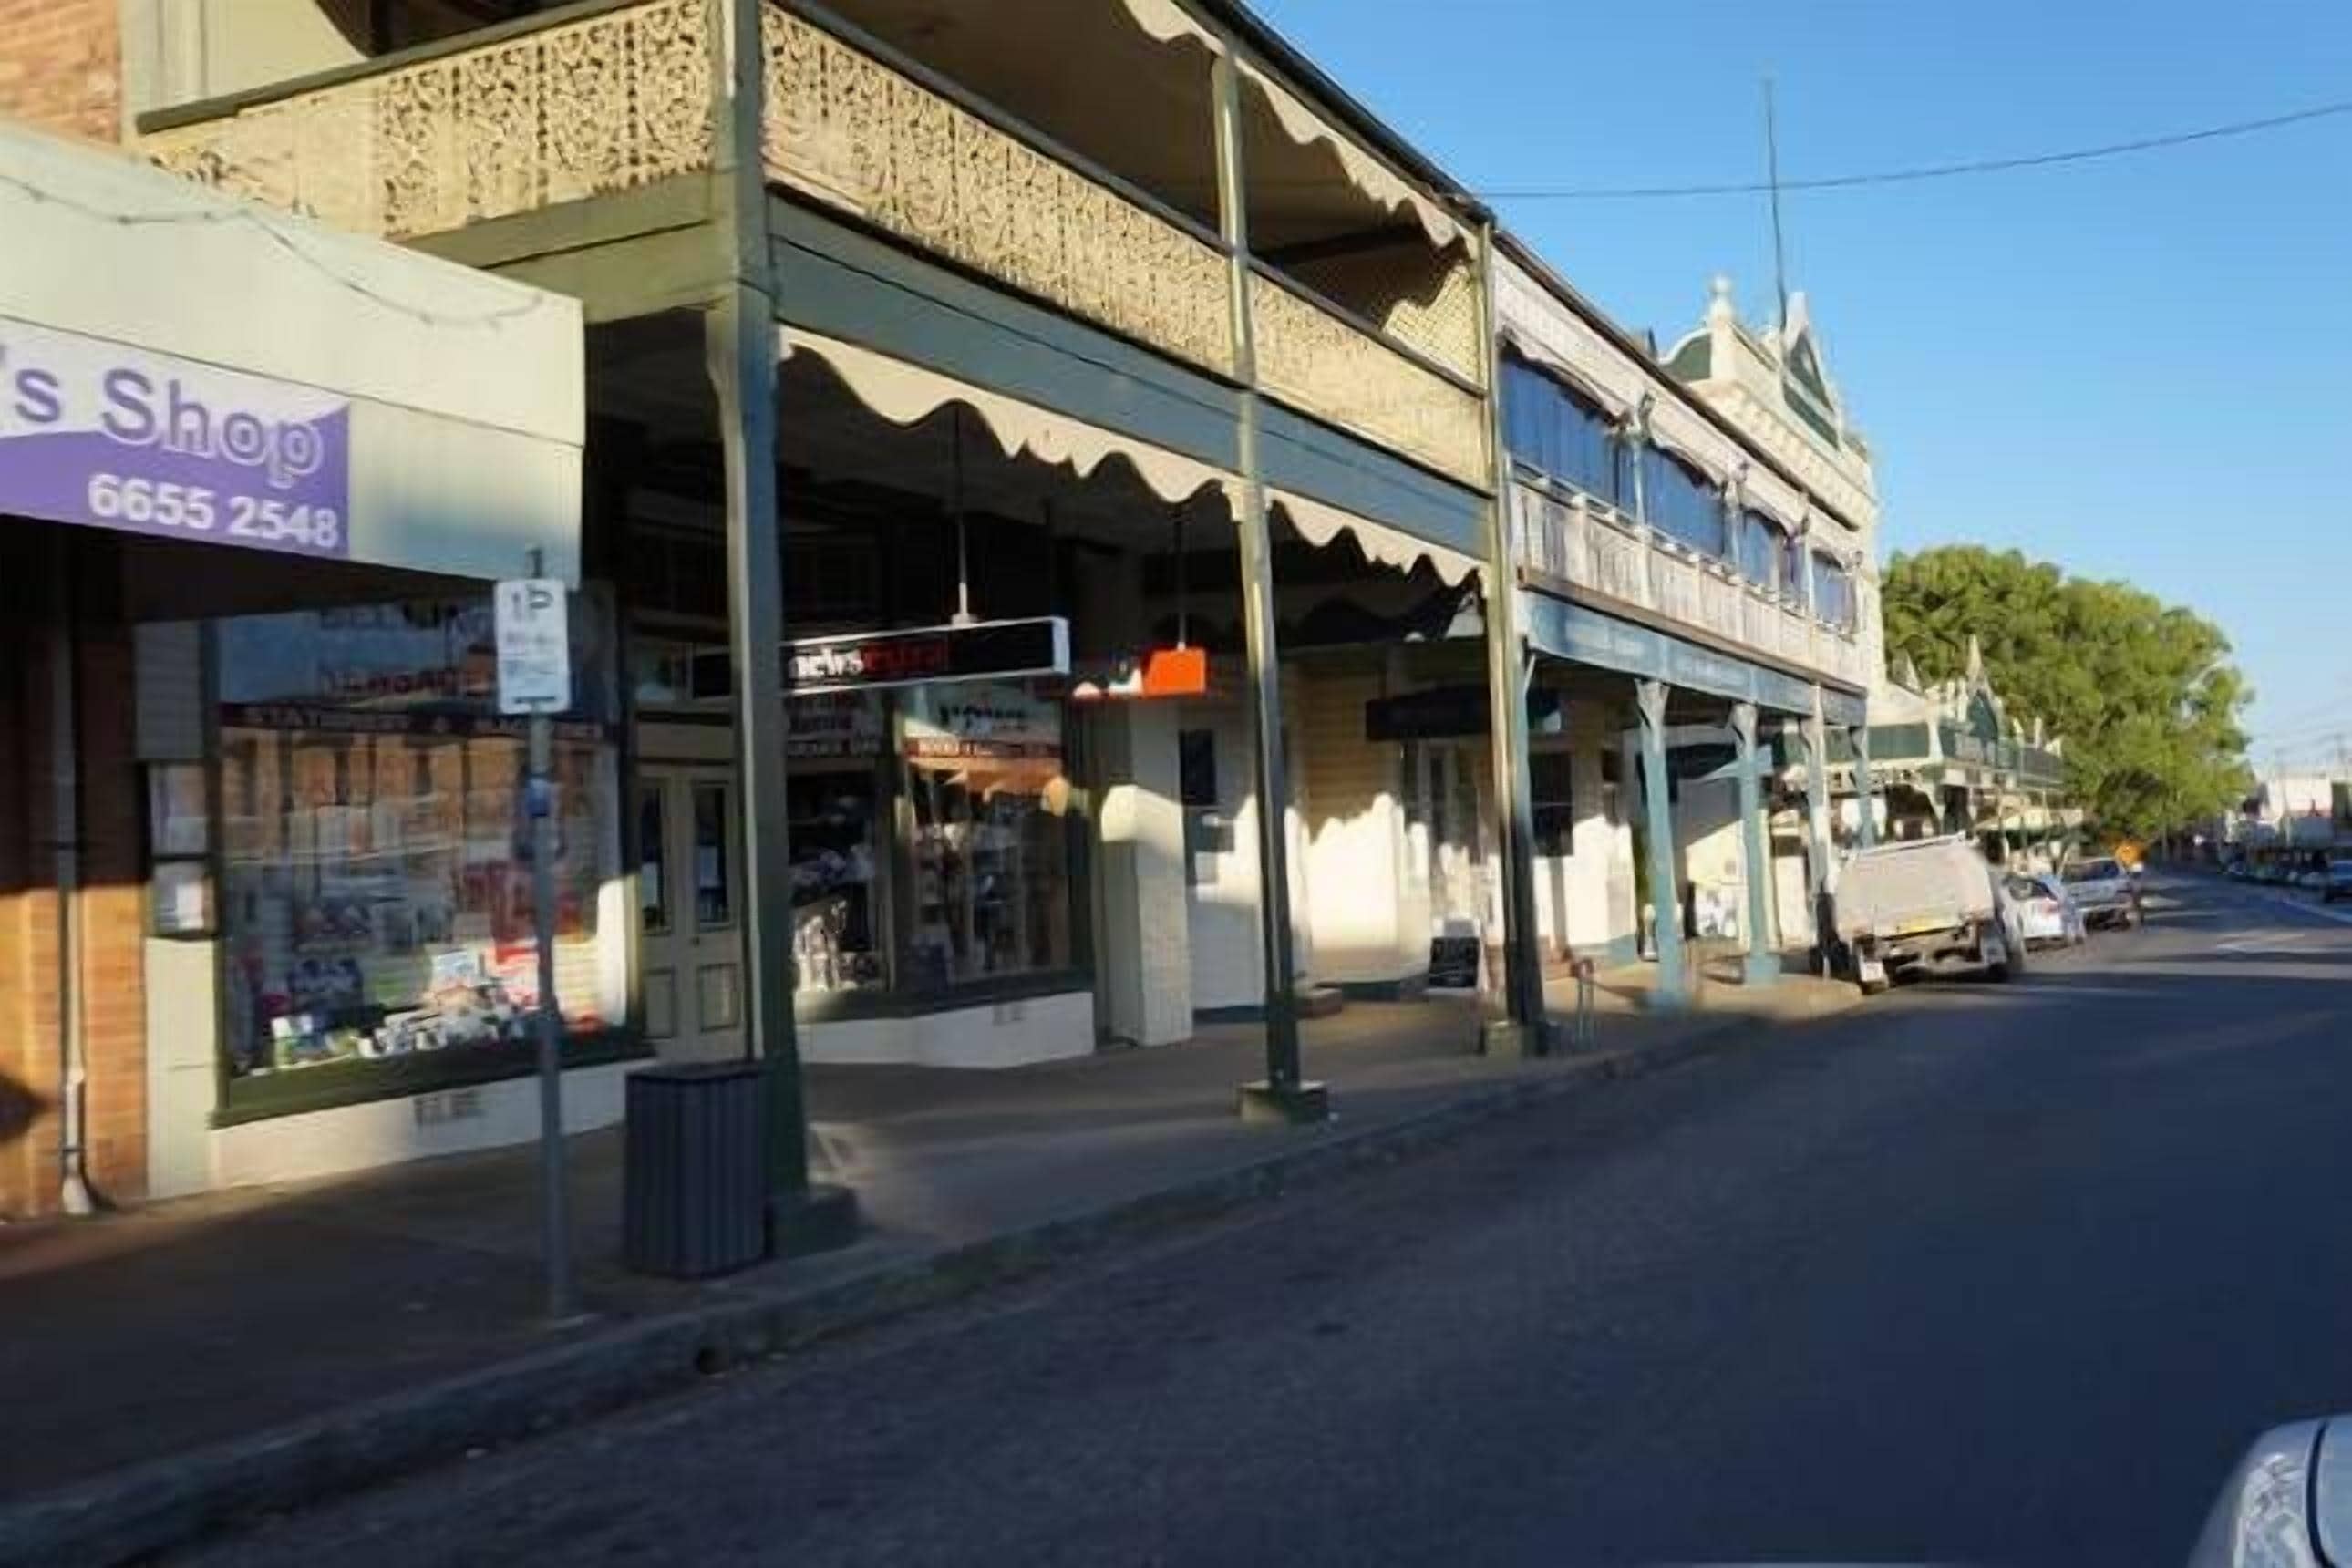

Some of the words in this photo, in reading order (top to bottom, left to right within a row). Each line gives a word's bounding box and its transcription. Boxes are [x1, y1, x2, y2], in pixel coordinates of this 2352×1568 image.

[102, 367, 323, 489] Shop
[88, 473, 217, 530] 6655
[229, 496, 339, 549] 2548
